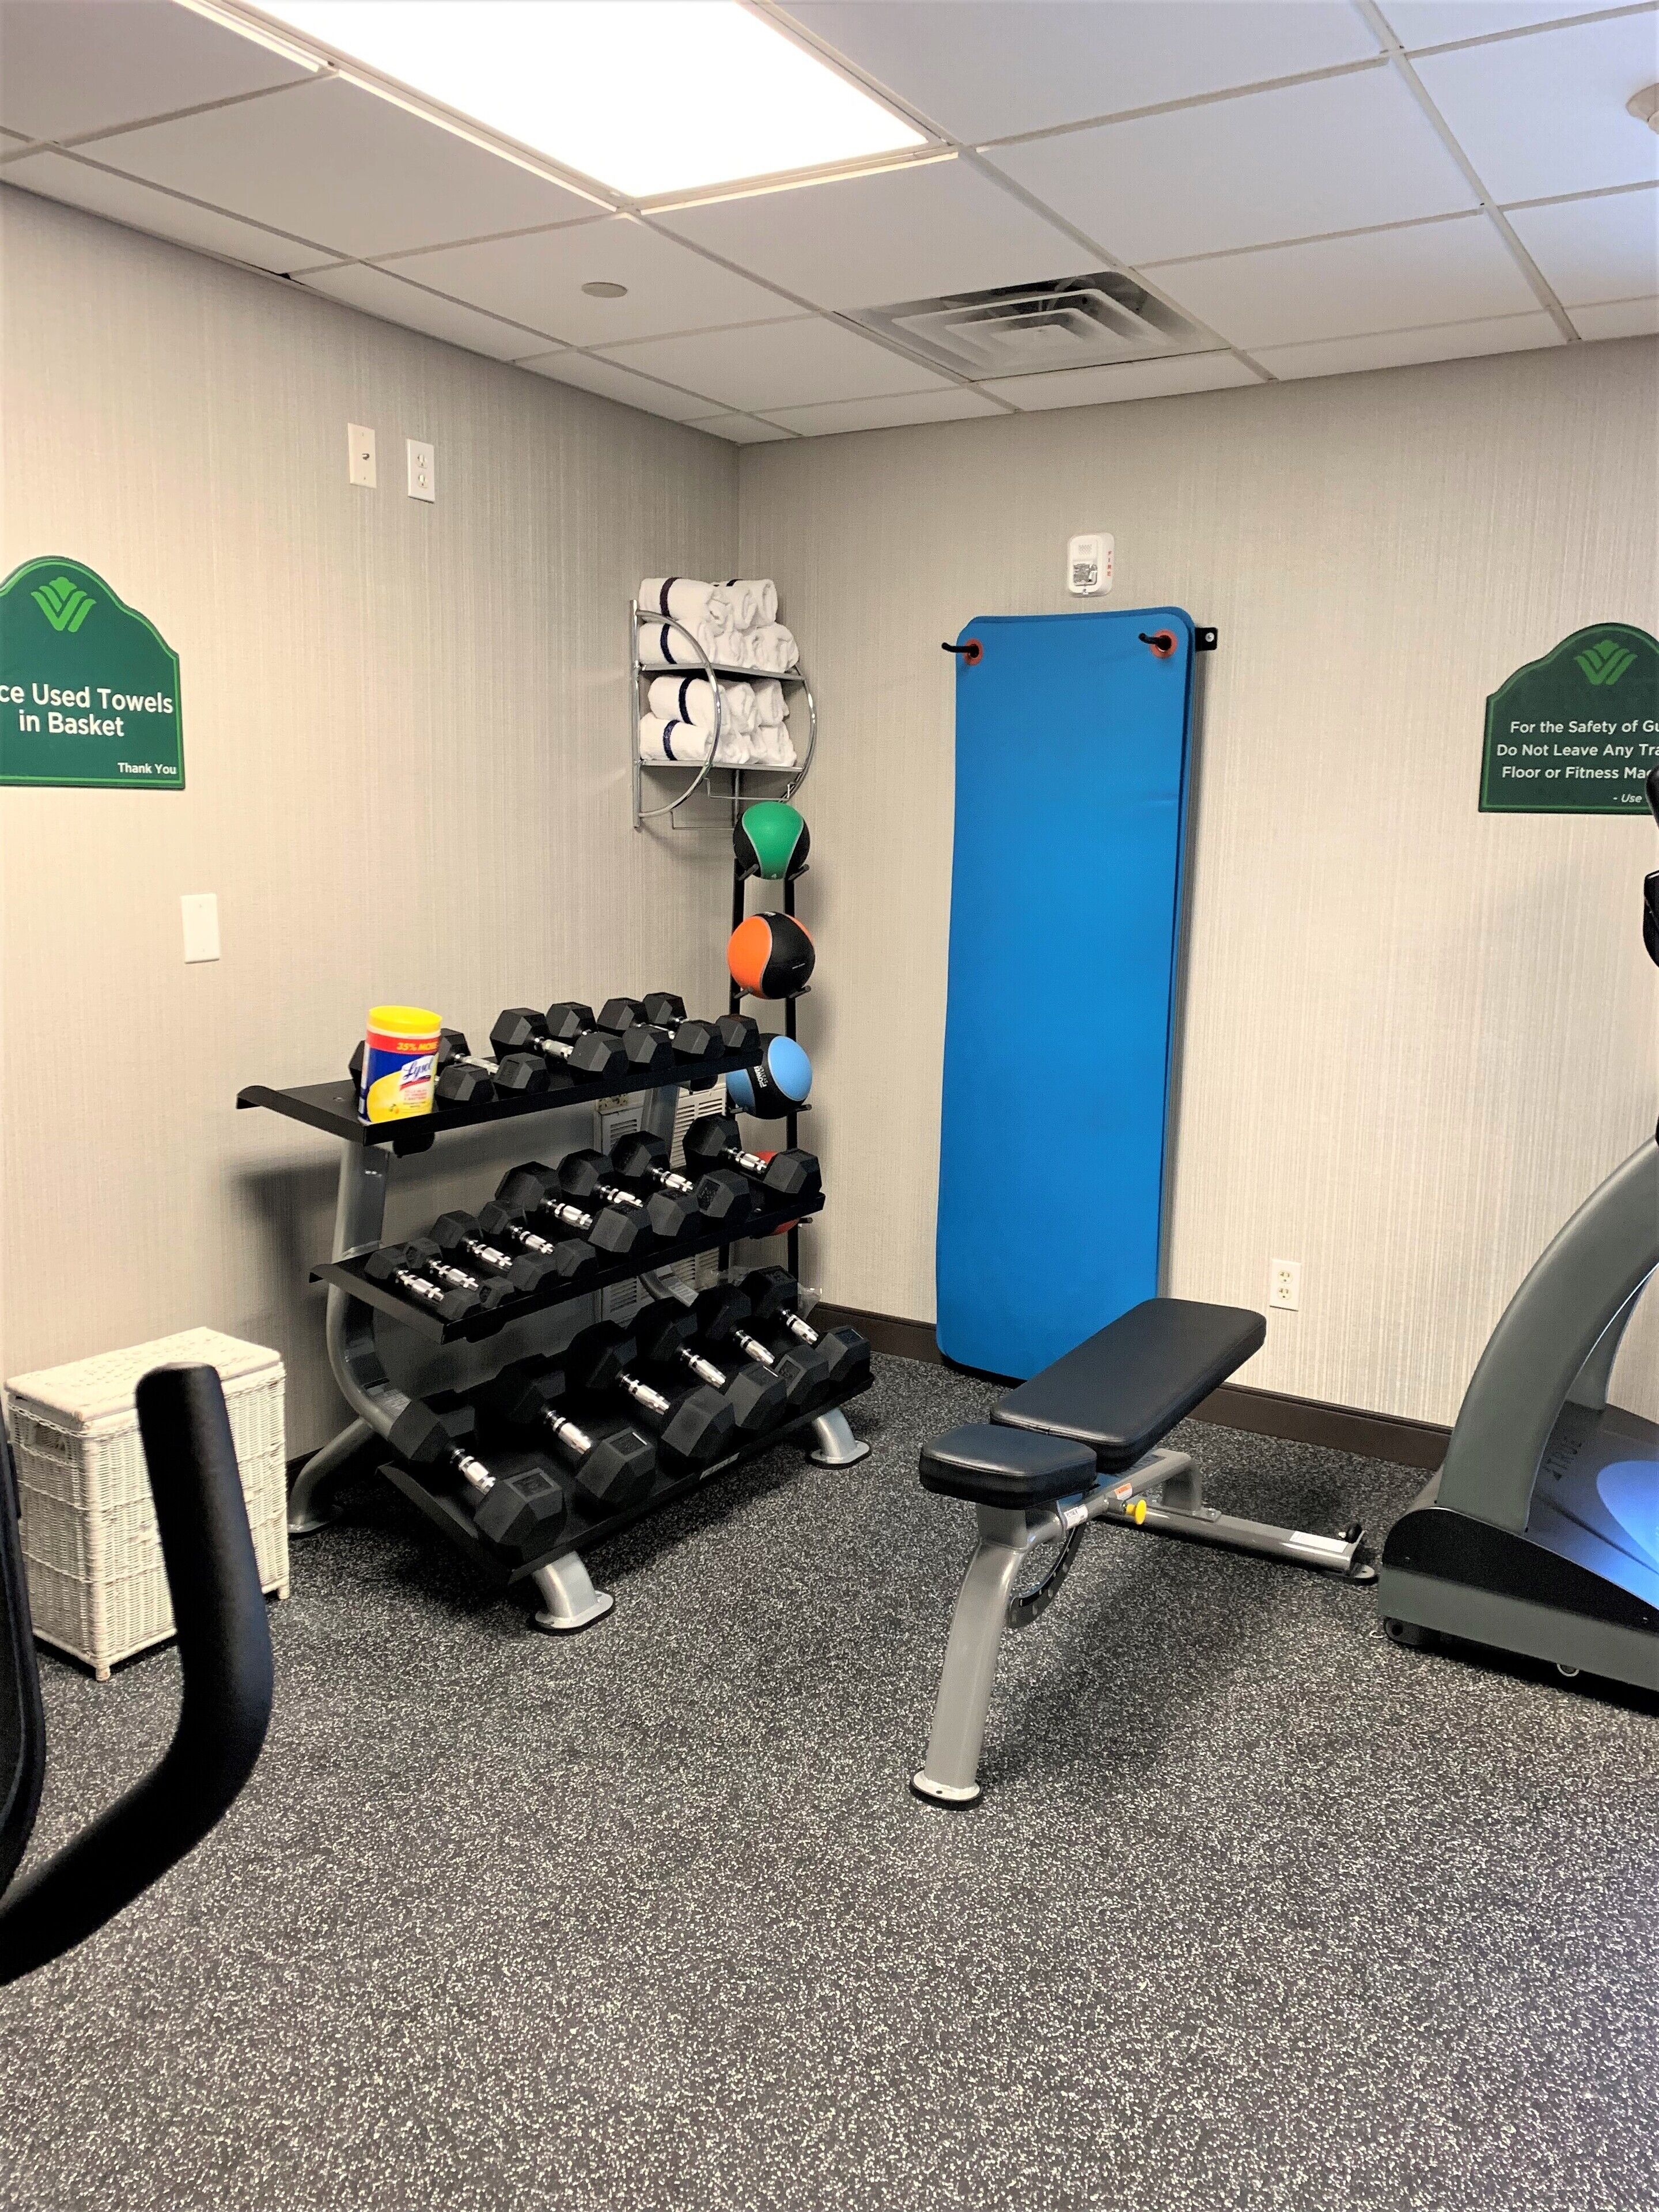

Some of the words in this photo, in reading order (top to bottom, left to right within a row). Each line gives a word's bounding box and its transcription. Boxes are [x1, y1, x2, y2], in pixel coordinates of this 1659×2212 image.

[0, 684, 25, 703] ce
[32, 683, 90, 709] Used
[97, 688, 173, 714] Towels
[19, 709, 40, 732] in
[48, 711, 124, 737] Basket
[1510, 721, 1535, 733] For
[1540, 721, 1564, 733] the
[1569, 720, 1617, 734] Safety
[1622, 720, 1639, 732] of
[1497, 744, 1517, 756] Do
[1521, 744, 1549, 756] Not
[1553, 744, 1599, 756] Leave
[1603, 744, 1634, 758] Any
[118, 762, 153, 774] Thank
[154, 763, 177, 775] You
[1502, 766, 1541, 778] Floor
[1545, 768, 1561, 778] or
[1565, 767, 1619, 779] Fitness
[1621, 794, 1642, 803] Use
[396, 1042, 418, 1051] 35%
[403, 1057, 433, 1080] Lysol
